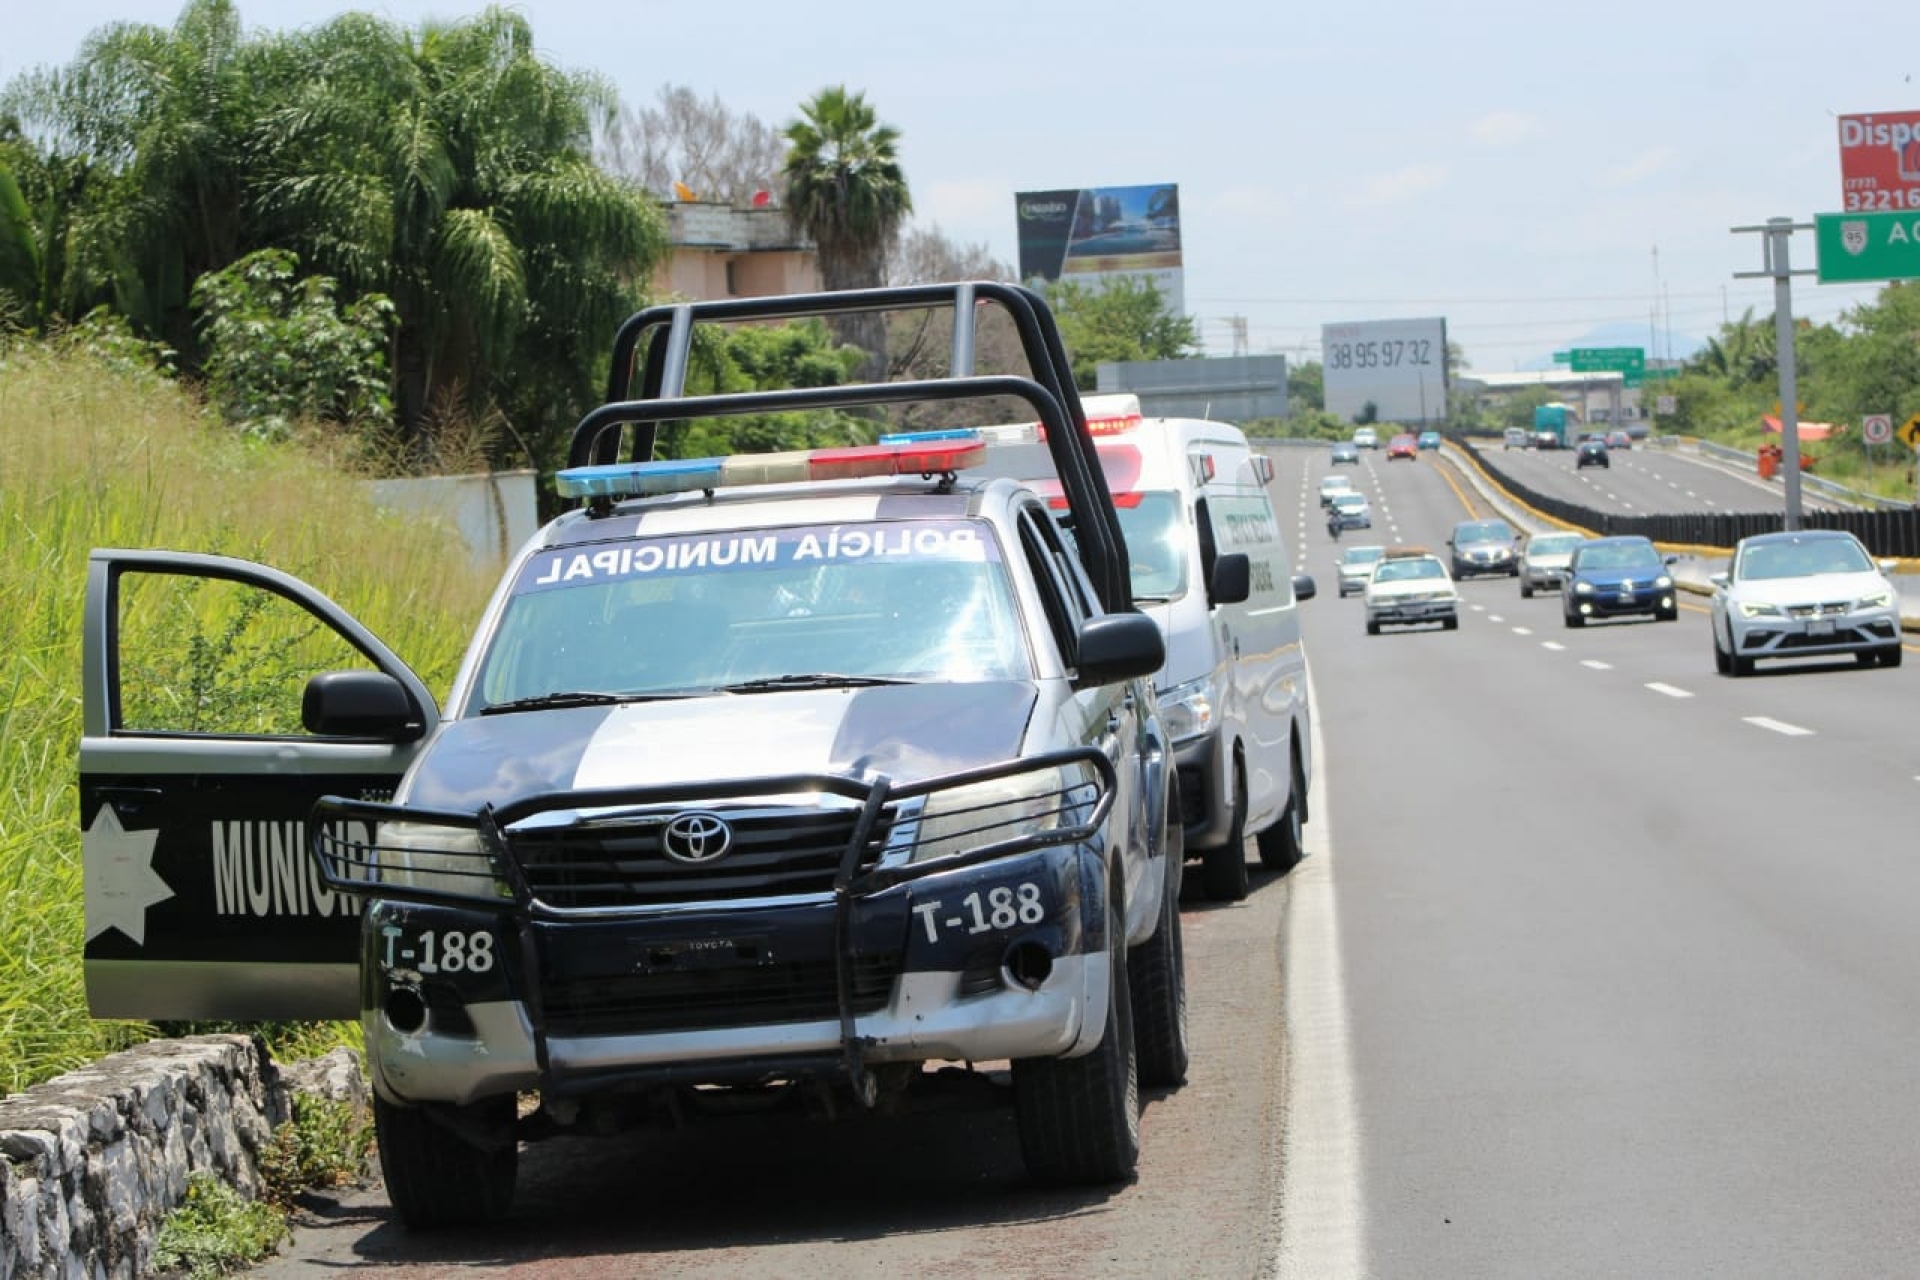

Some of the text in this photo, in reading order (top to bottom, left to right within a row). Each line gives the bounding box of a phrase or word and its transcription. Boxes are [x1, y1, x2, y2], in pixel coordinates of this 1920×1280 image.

[1331, 339, 1431, 369] 38 95 97 32
[212, 820, 379, 918] MUNICIP
[912, 882, 1044, 944] T-188
[382, 926, 493, 973] T-188
